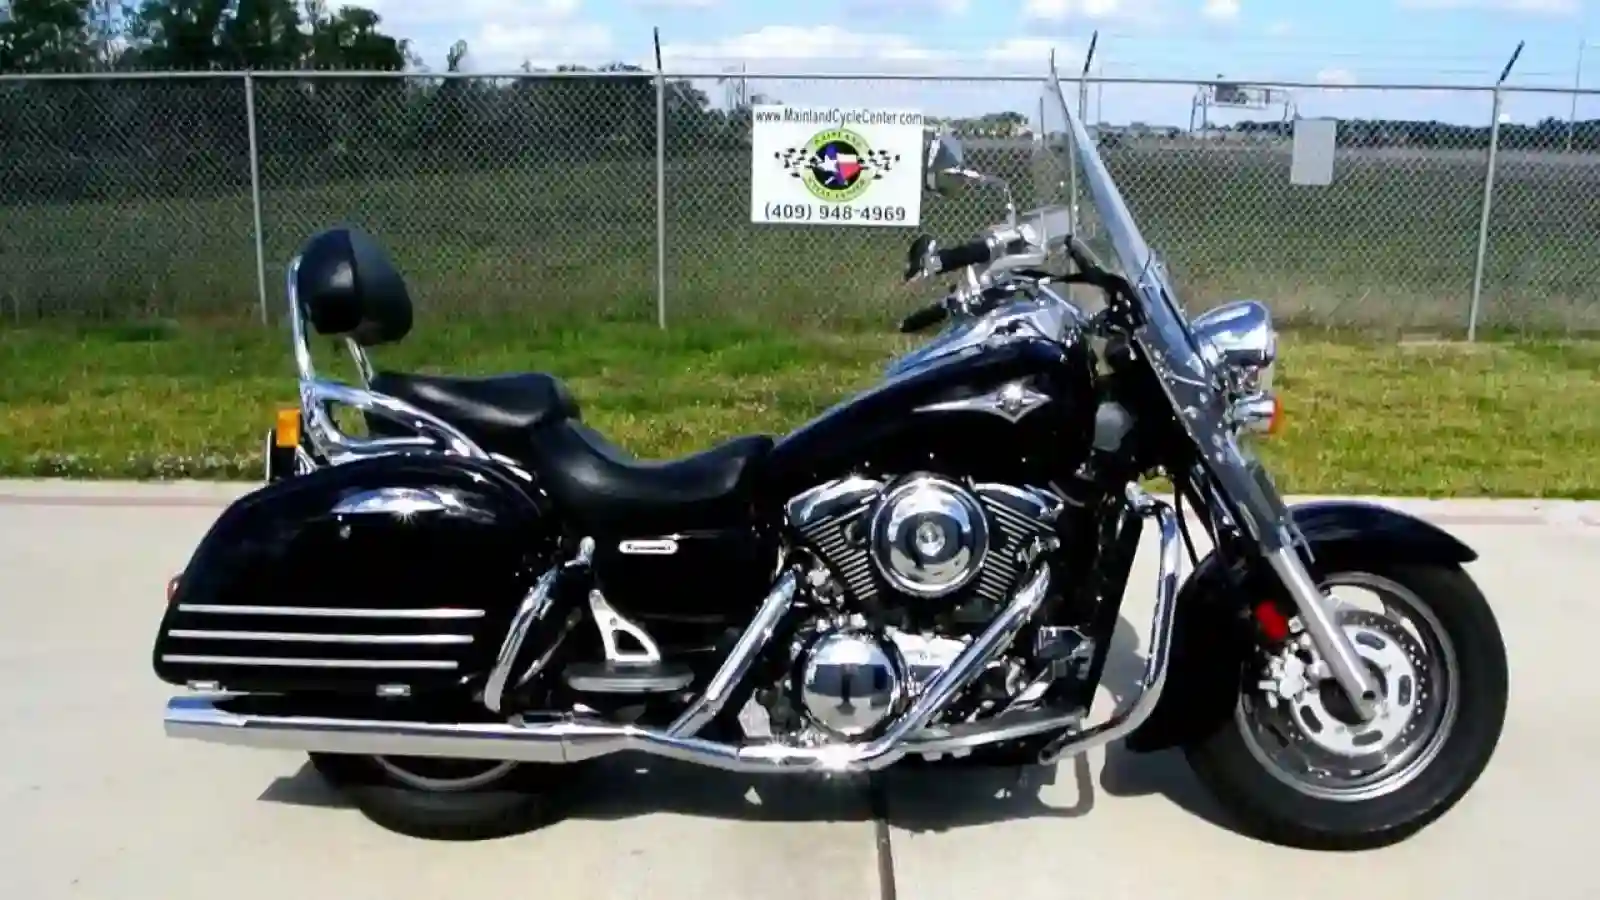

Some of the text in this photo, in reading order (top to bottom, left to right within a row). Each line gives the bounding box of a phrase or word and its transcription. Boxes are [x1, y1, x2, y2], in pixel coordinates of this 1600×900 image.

[756, 107, 922, 128] wwwMainlandCycleCentercom
[764, 202, 906, 221] (409) 948-4969
